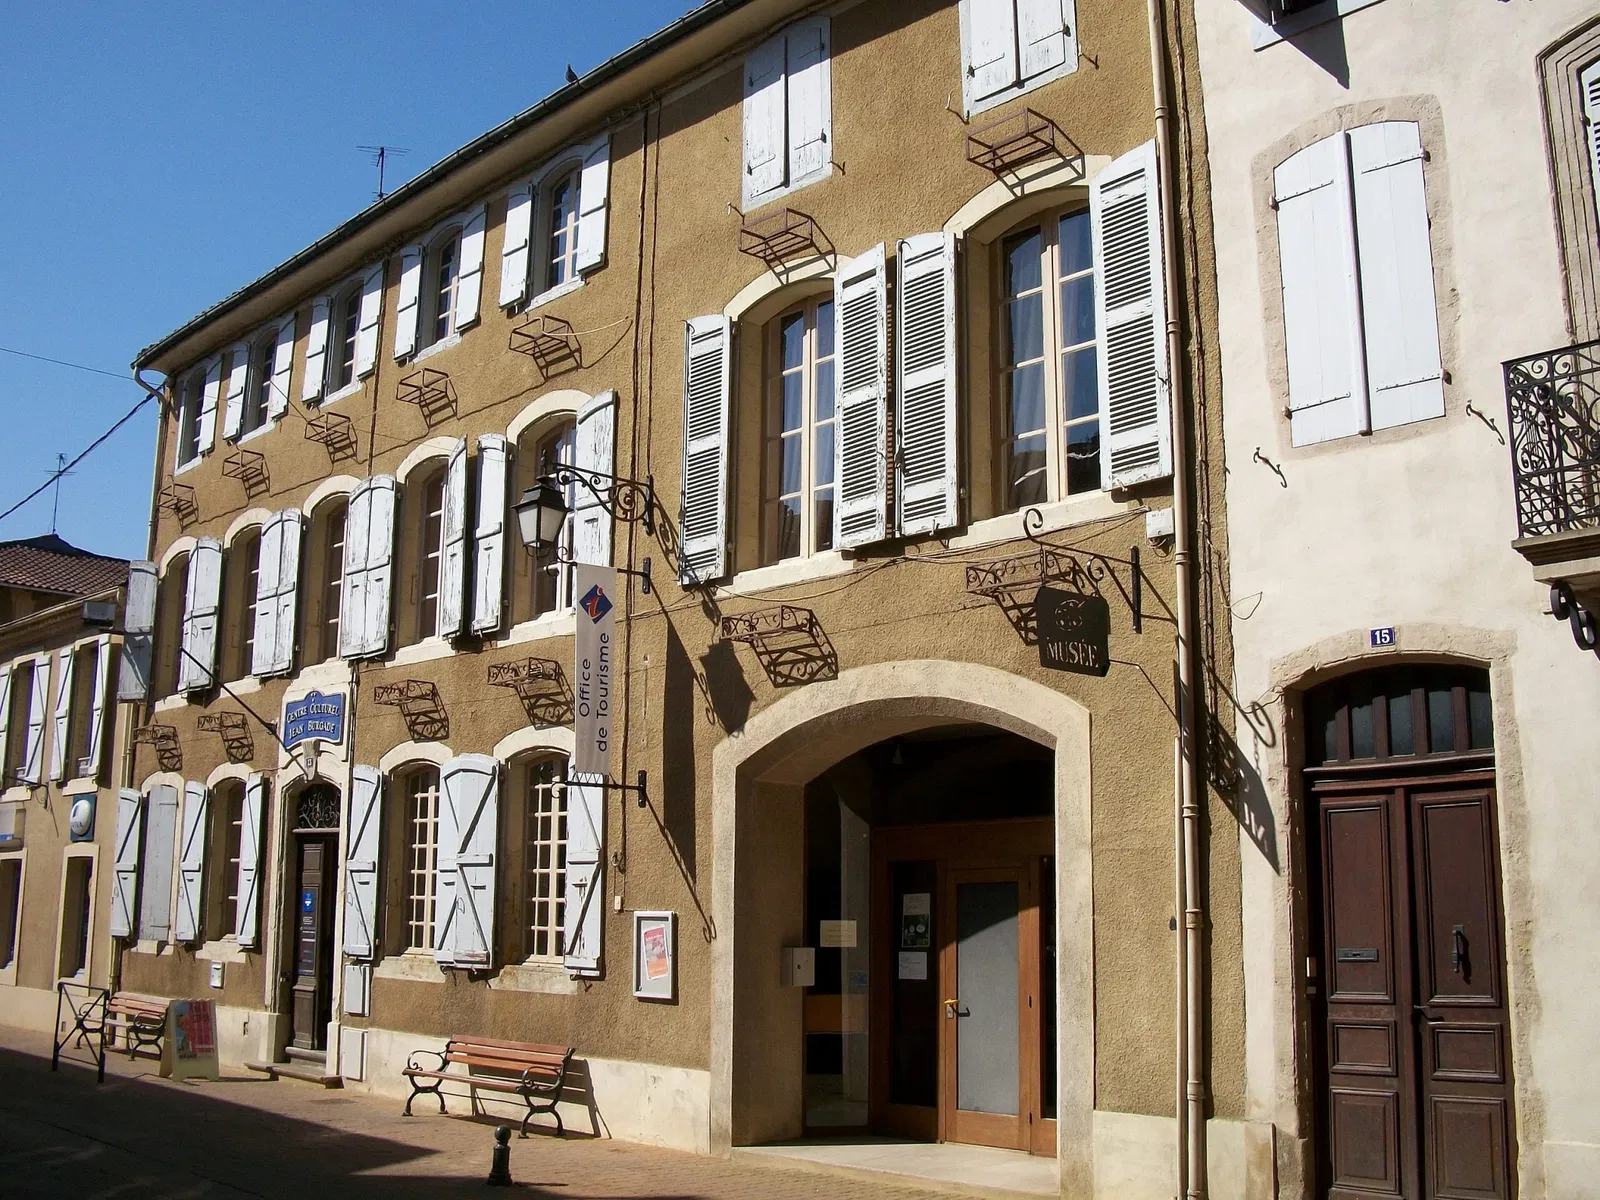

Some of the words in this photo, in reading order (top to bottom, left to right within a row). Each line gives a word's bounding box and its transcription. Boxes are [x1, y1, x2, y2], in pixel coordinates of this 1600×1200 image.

[1375, 629, 1390, 644] 15
[1046, 639, 1099, 668] MUSÉE
[579, 658, 592, 718] Office
[597, 632, 610, 719] Tourisme
[287, 705, 308, 723] CENTRE
[310, 703, 339, 716] CULTUREL
[289, 723, 304, 739] JEAN
[308, 720, 335, 733] BURGADE
[597, 726, 609, 751] de
